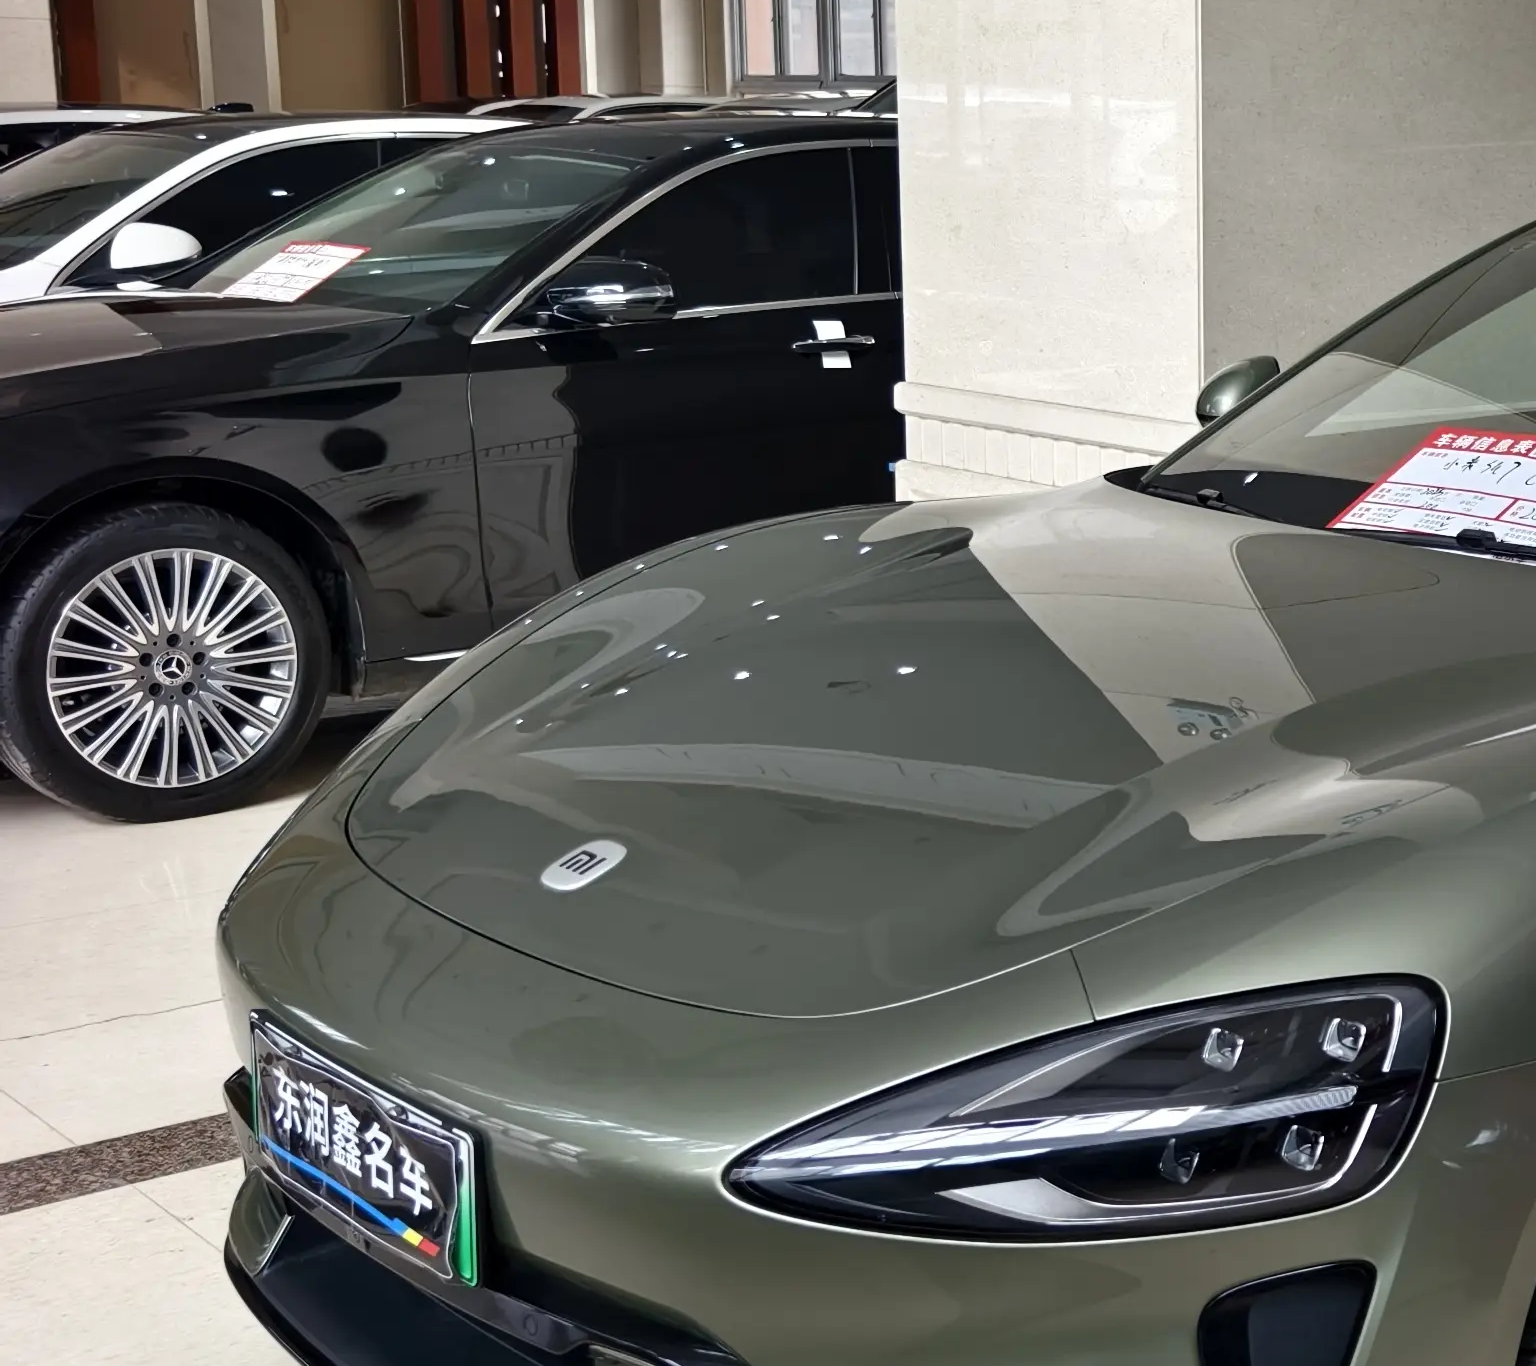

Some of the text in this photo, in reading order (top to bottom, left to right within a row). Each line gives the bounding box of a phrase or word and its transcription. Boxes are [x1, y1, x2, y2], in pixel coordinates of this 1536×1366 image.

[1433, 432, 1536, 454] 车辆信息表
[273, 1066, 433, 1216] 东润鑫名车
